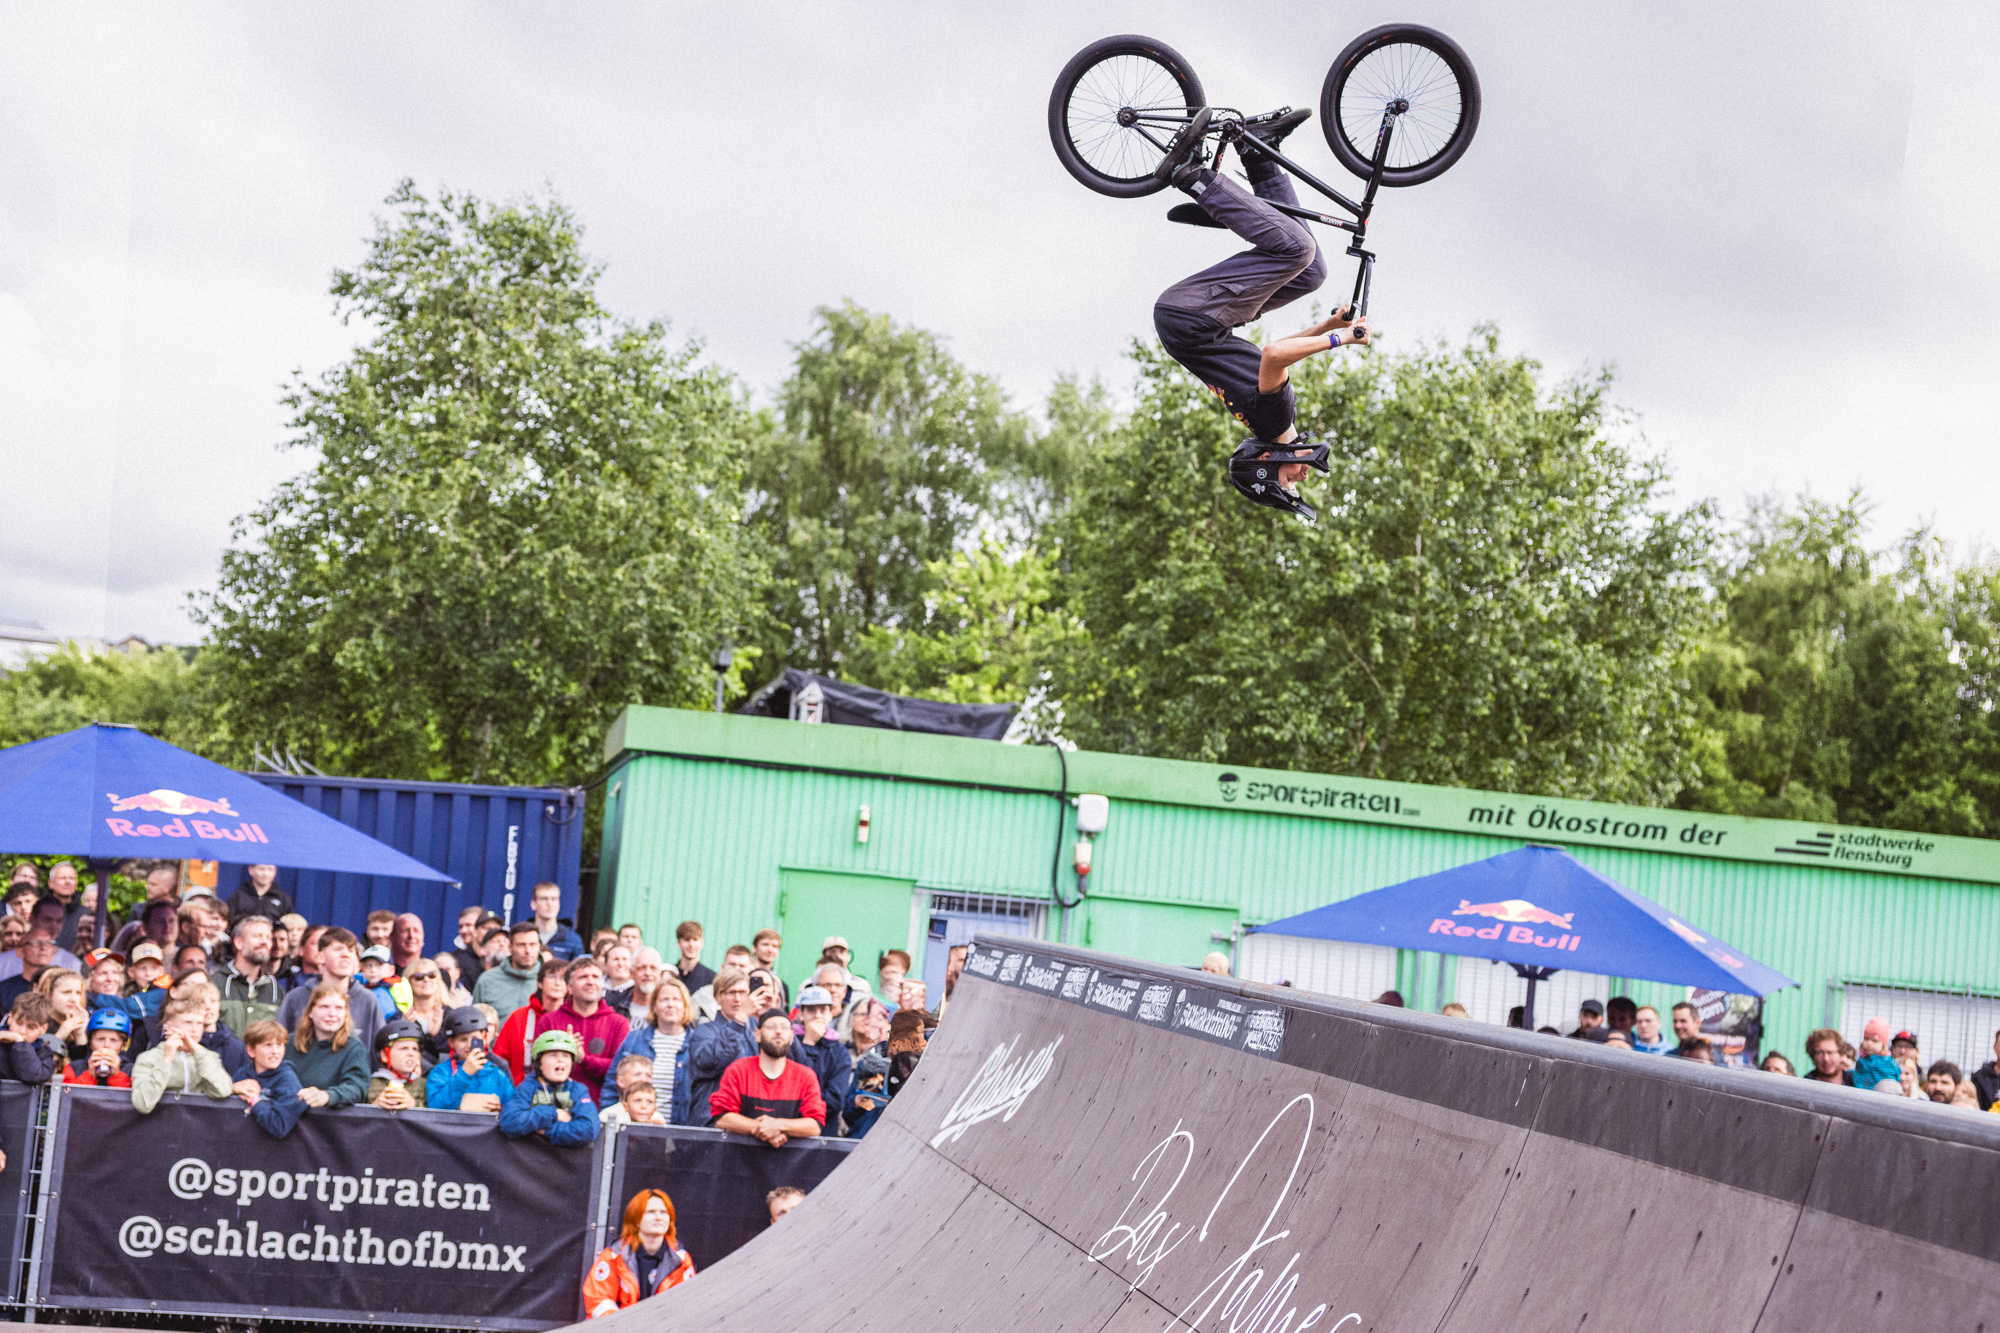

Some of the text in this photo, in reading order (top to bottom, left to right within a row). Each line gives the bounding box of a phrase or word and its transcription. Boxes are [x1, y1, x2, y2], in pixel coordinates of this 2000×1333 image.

[105, 817, 269, 844] Red Bull
[1468, 804, 1728, 846] mit Ökostrom der
[1833, 846, 1913, 869] flensburg
[1839, 832, 1935, 853] stadtwerke
[1429, 918, 1582, 952] Red Bull
[168, 1156, 492, 1213] @sportpiraten
[118, 1214, 527, 1274] @schlachthofbmx
